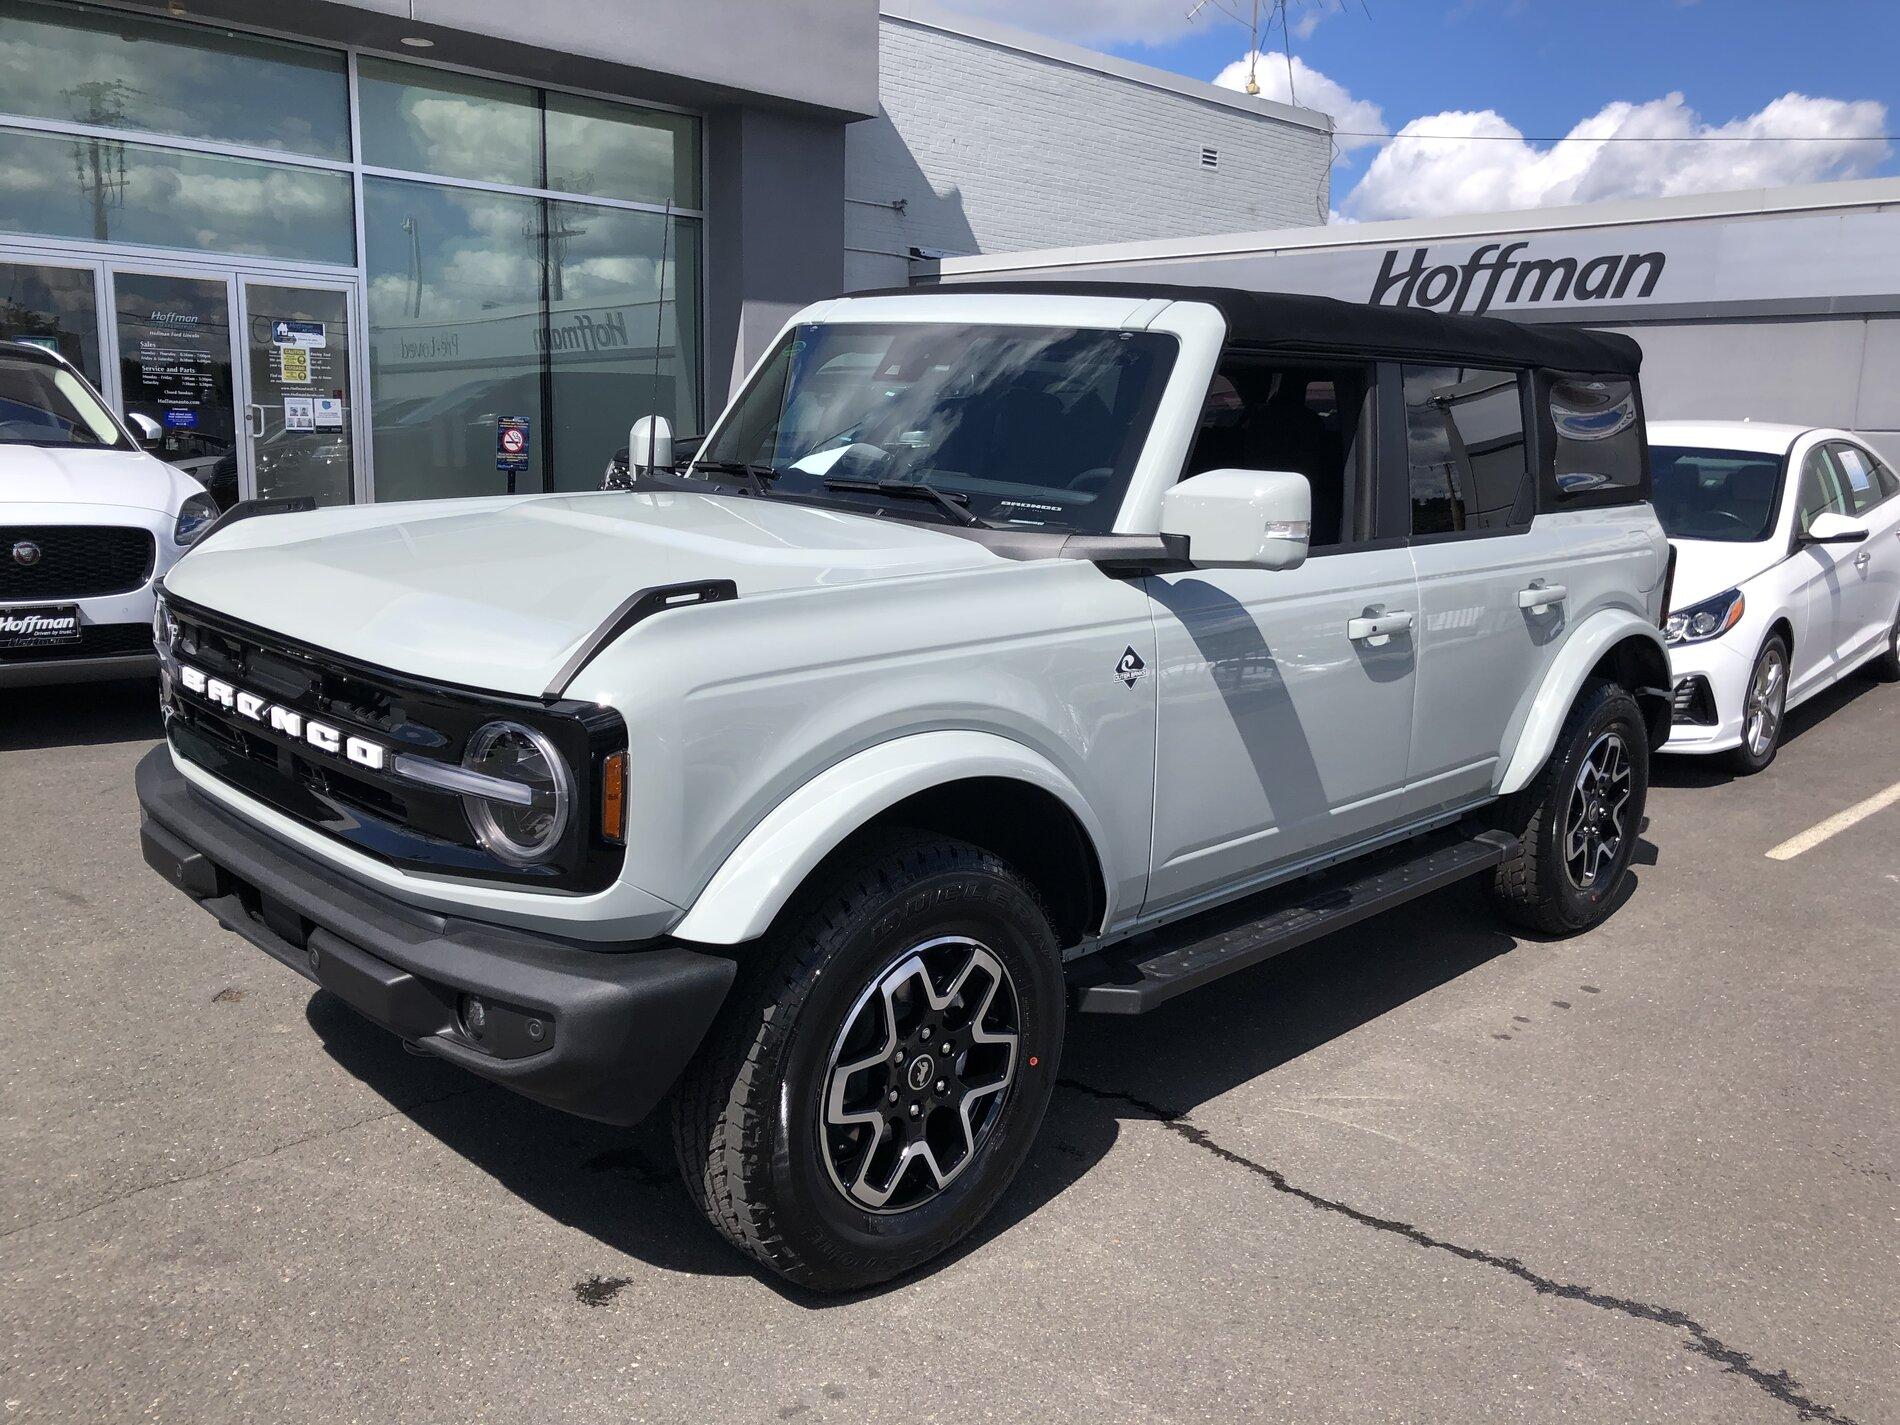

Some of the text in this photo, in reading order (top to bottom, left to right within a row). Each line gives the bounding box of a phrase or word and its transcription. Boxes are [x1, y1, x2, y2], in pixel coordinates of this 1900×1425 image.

[1369, 242, 1666, 316] Hoffman
[150, 311, 199, 323] Hoffman
[1001, 501, 1062, 511] BRONCO
[0, 615, 75, 634] Hoffman
[180, 664, 384, 770] BRONCO
